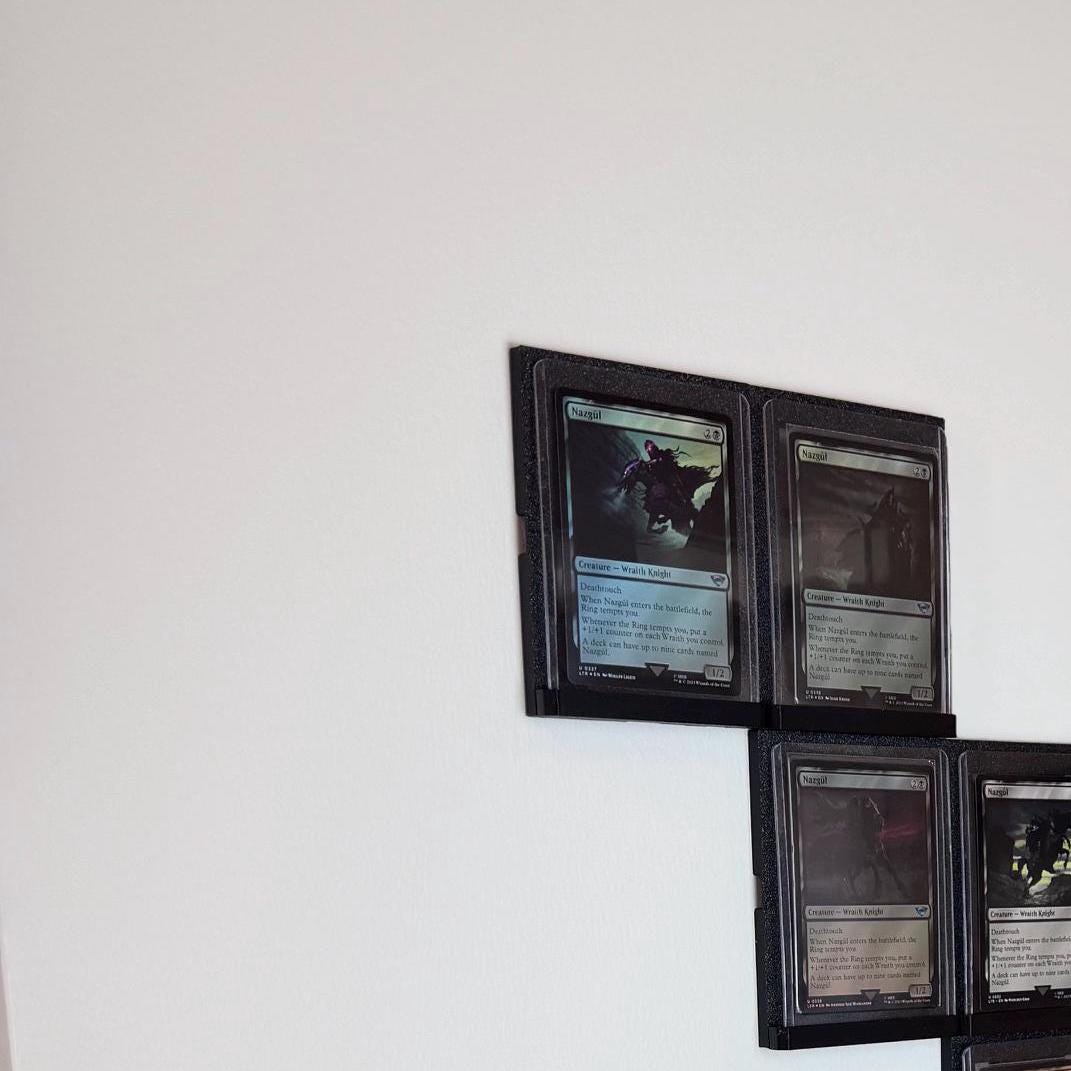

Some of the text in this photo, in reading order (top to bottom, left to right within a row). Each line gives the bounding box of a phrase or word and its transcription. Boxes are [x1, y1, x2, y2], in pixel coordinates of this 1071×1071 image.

[571, 407, 602, 421] Nazgûl
[578, 560, 611, 571] Creature
[621, 565, 646, 576] Wraith
[648, 568, 671, 580] Knight
[580, 595, 602, 604] When
[630, 602, 651, 610] enters
[653, 603, 664, 611] the
[807, 592, 834, 602] Creature
[865, 598, 885, 609] Knight
[581, 604, 598, 614] Ring
[581, 616, 617, 627] Whenever
[618, 620, 630, 628] the
[632, 621, 648, 631] Ring
[623, 641, 639, 650] have
[712, 667, 725, 678] 1/2
[917, 689, 928, 698] 1/2
